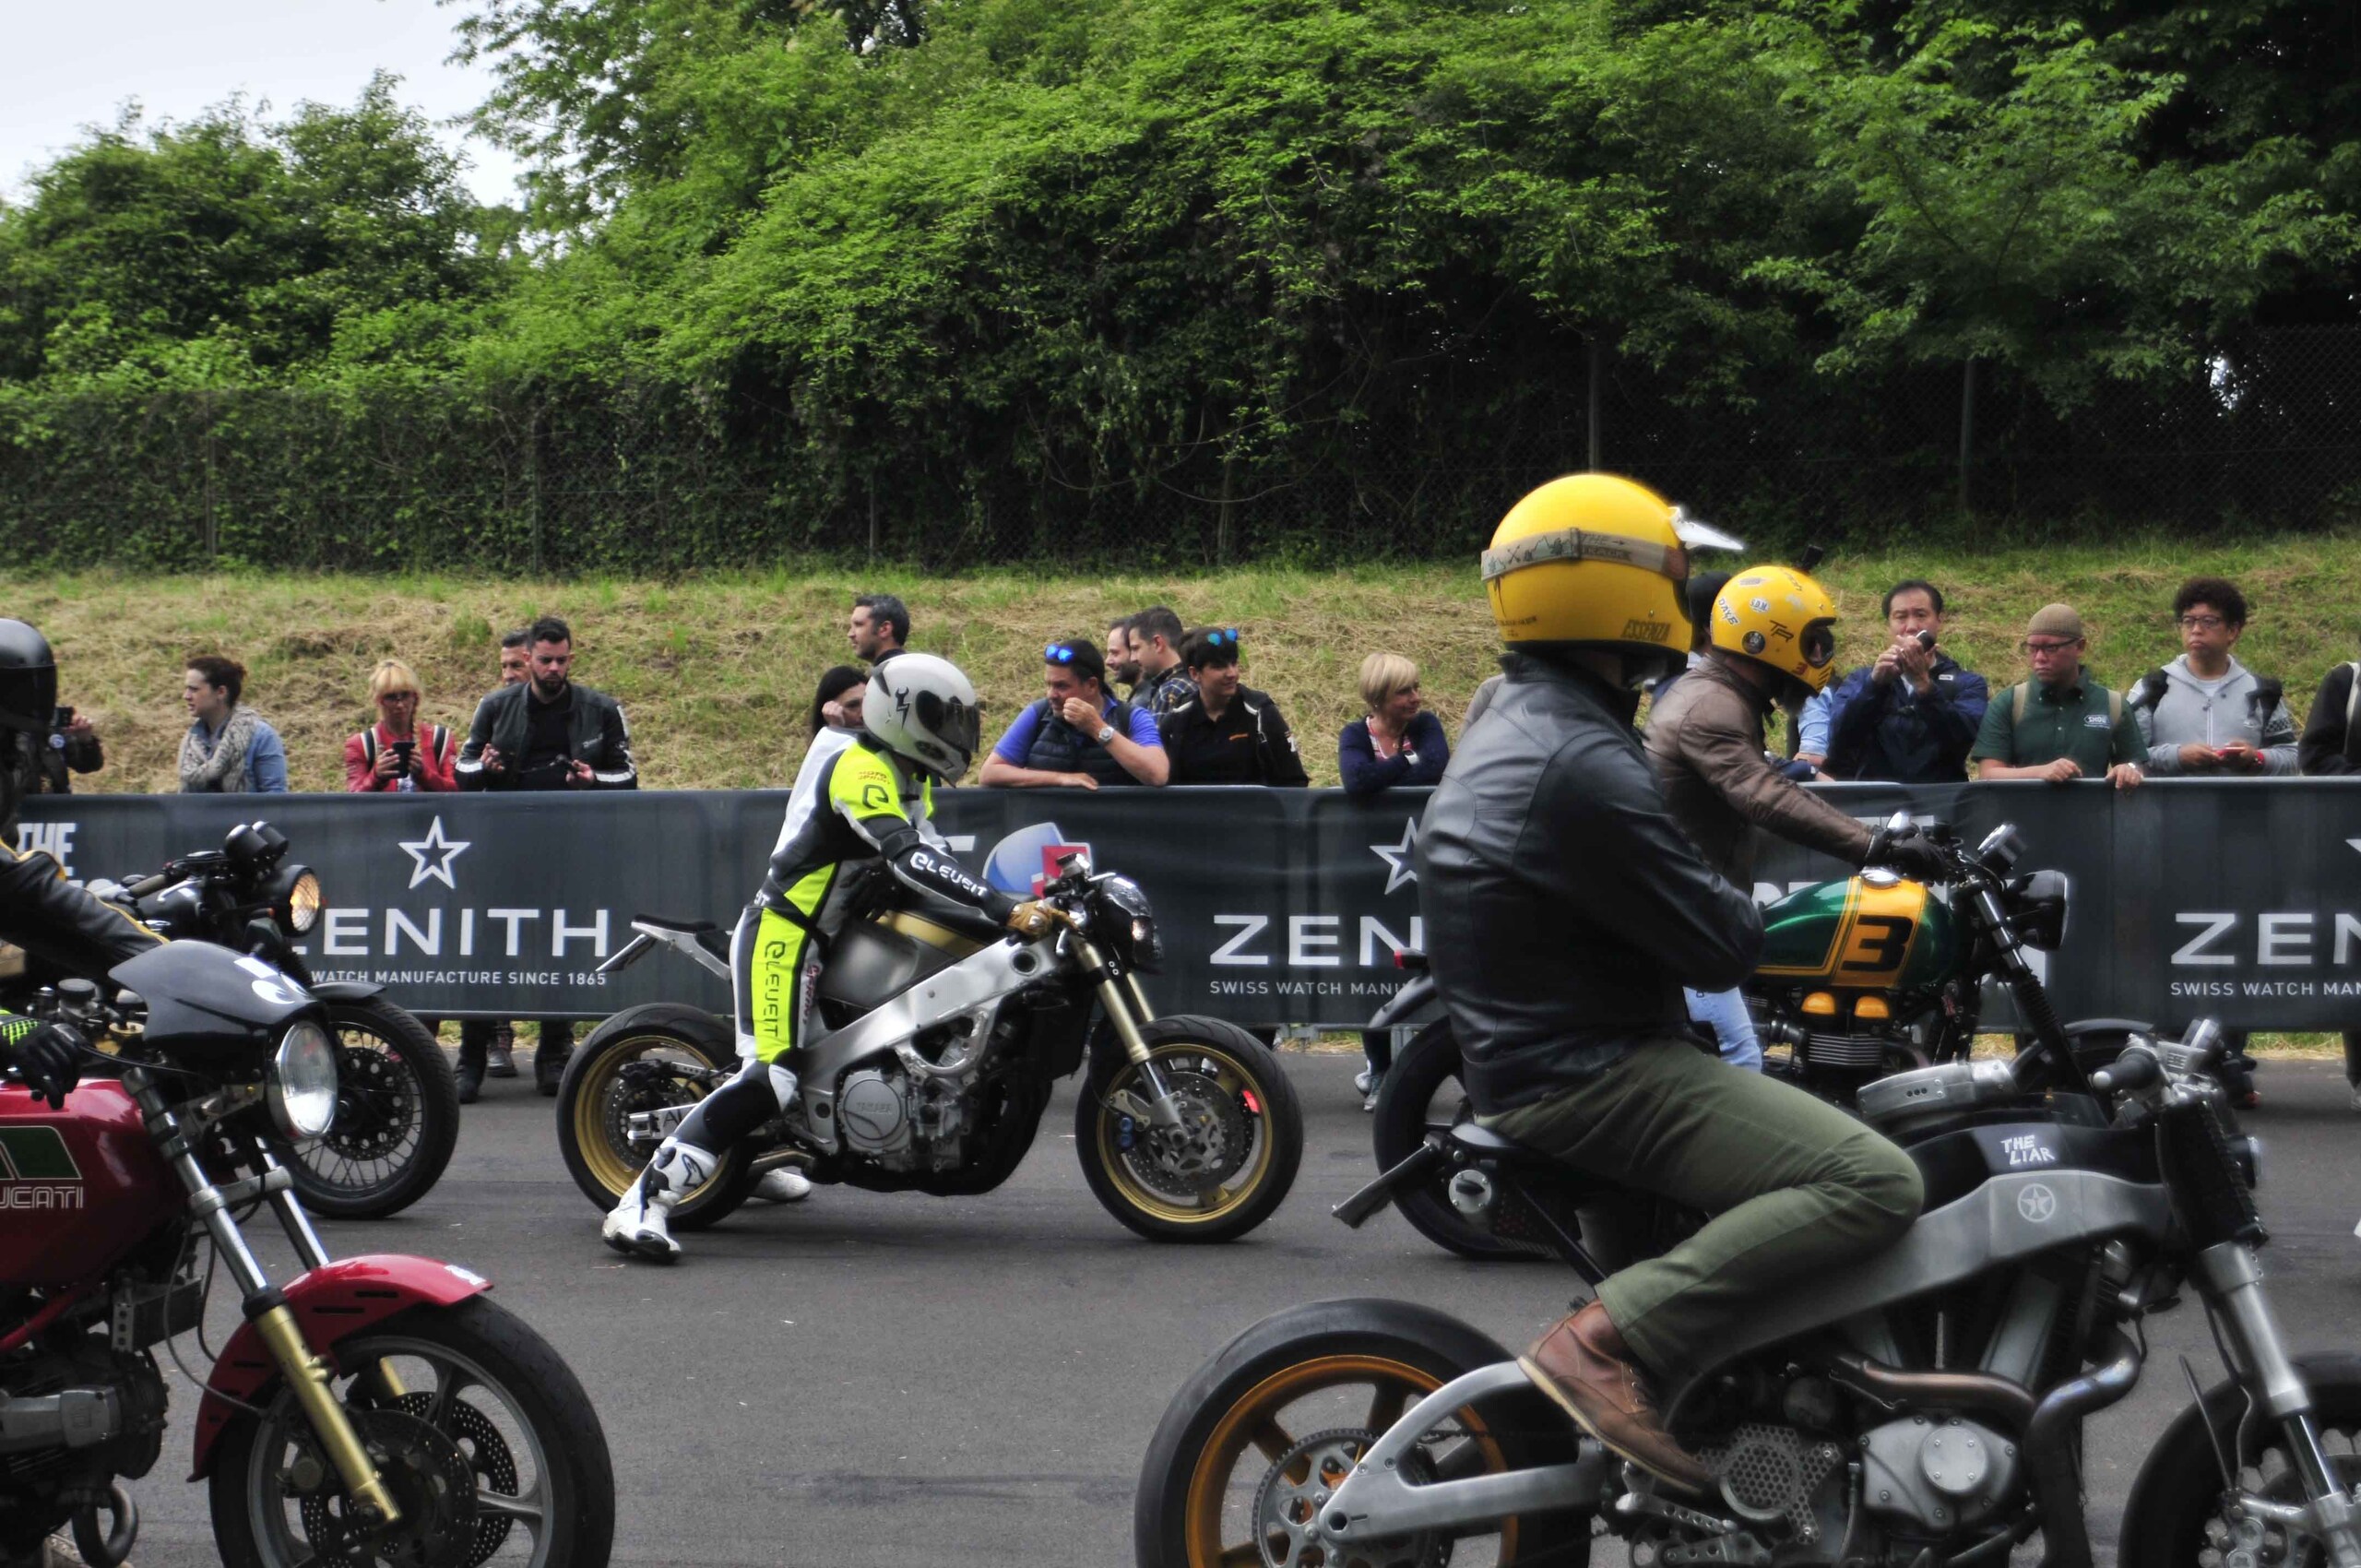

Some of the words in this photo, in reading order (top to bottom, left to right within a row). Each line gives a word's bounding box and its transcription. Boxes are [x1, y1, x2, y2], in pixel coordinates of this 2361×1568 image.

[291, 908, 609, 957] ENITH
[1841, 915, 1915, 972] 3
[311, 970, 368, 983] WATCH
[374, 971, 502, 985] MANUFACTURE
[507, 972, 560, 986] SINCE
[566, 972, 607, 986] 1865
[1209, 980, 1269, 995] SWISS
[1275, 981, 1342, 995] WATCH
[2170, 981, 2235, 996] SWISS
[2242, 981, 2314, 996] WATCH
[1999, 1134, 2035, 1153] THE
[2010, 1146, 2056, 1165] LIAR
